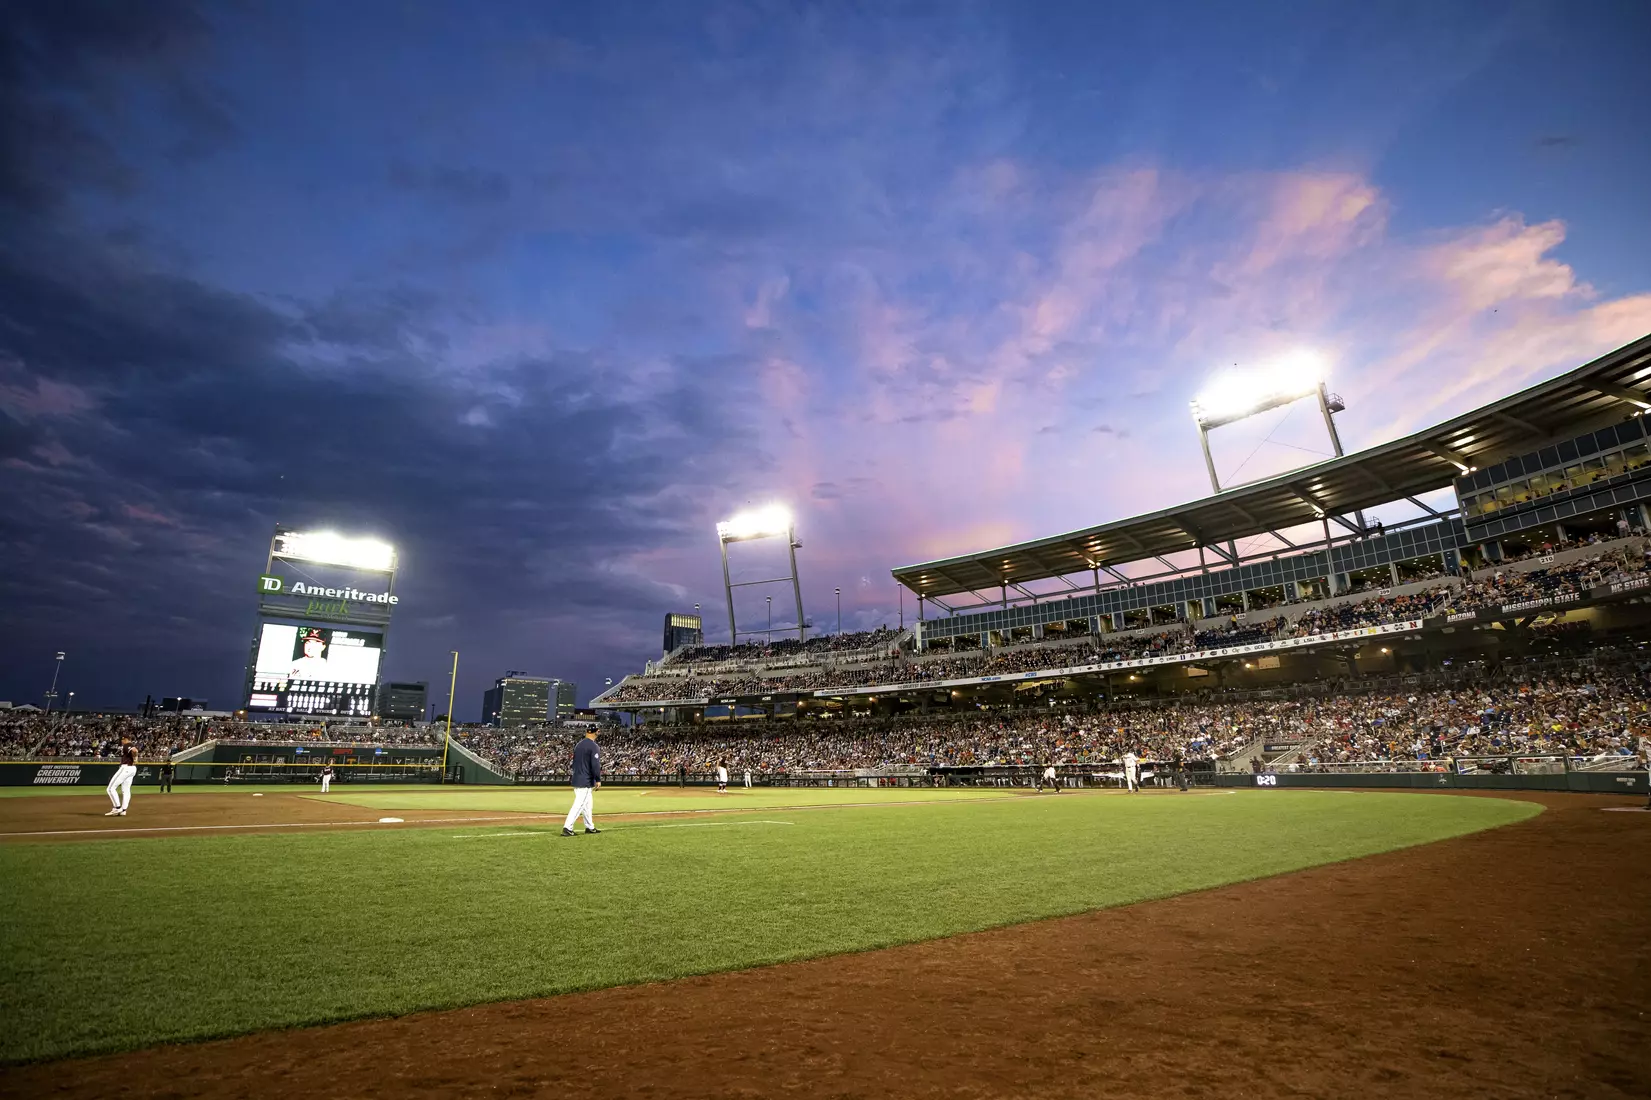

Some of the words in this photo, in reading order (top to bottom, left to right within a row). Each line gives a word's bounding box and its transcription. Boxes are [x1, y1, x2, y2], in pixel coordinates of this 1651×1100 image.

[261, 577, 281, 591] TD
[291, 581, 399, 605] Ameritrade
[1611, 583, 1623, 593] NC
[1624, 577, 1650, 592] STATE
[304, 599, 349, 616] park
[1502, 597, 1553, 613] MISSISSIPPI
[1554, 592, 1580, 604] STATE
[1447, 611, 1477, 623] ARIZONA
[37, 769, 81, 777] CREIGHTON
[1257, 775, 1276, 785] 0:20
